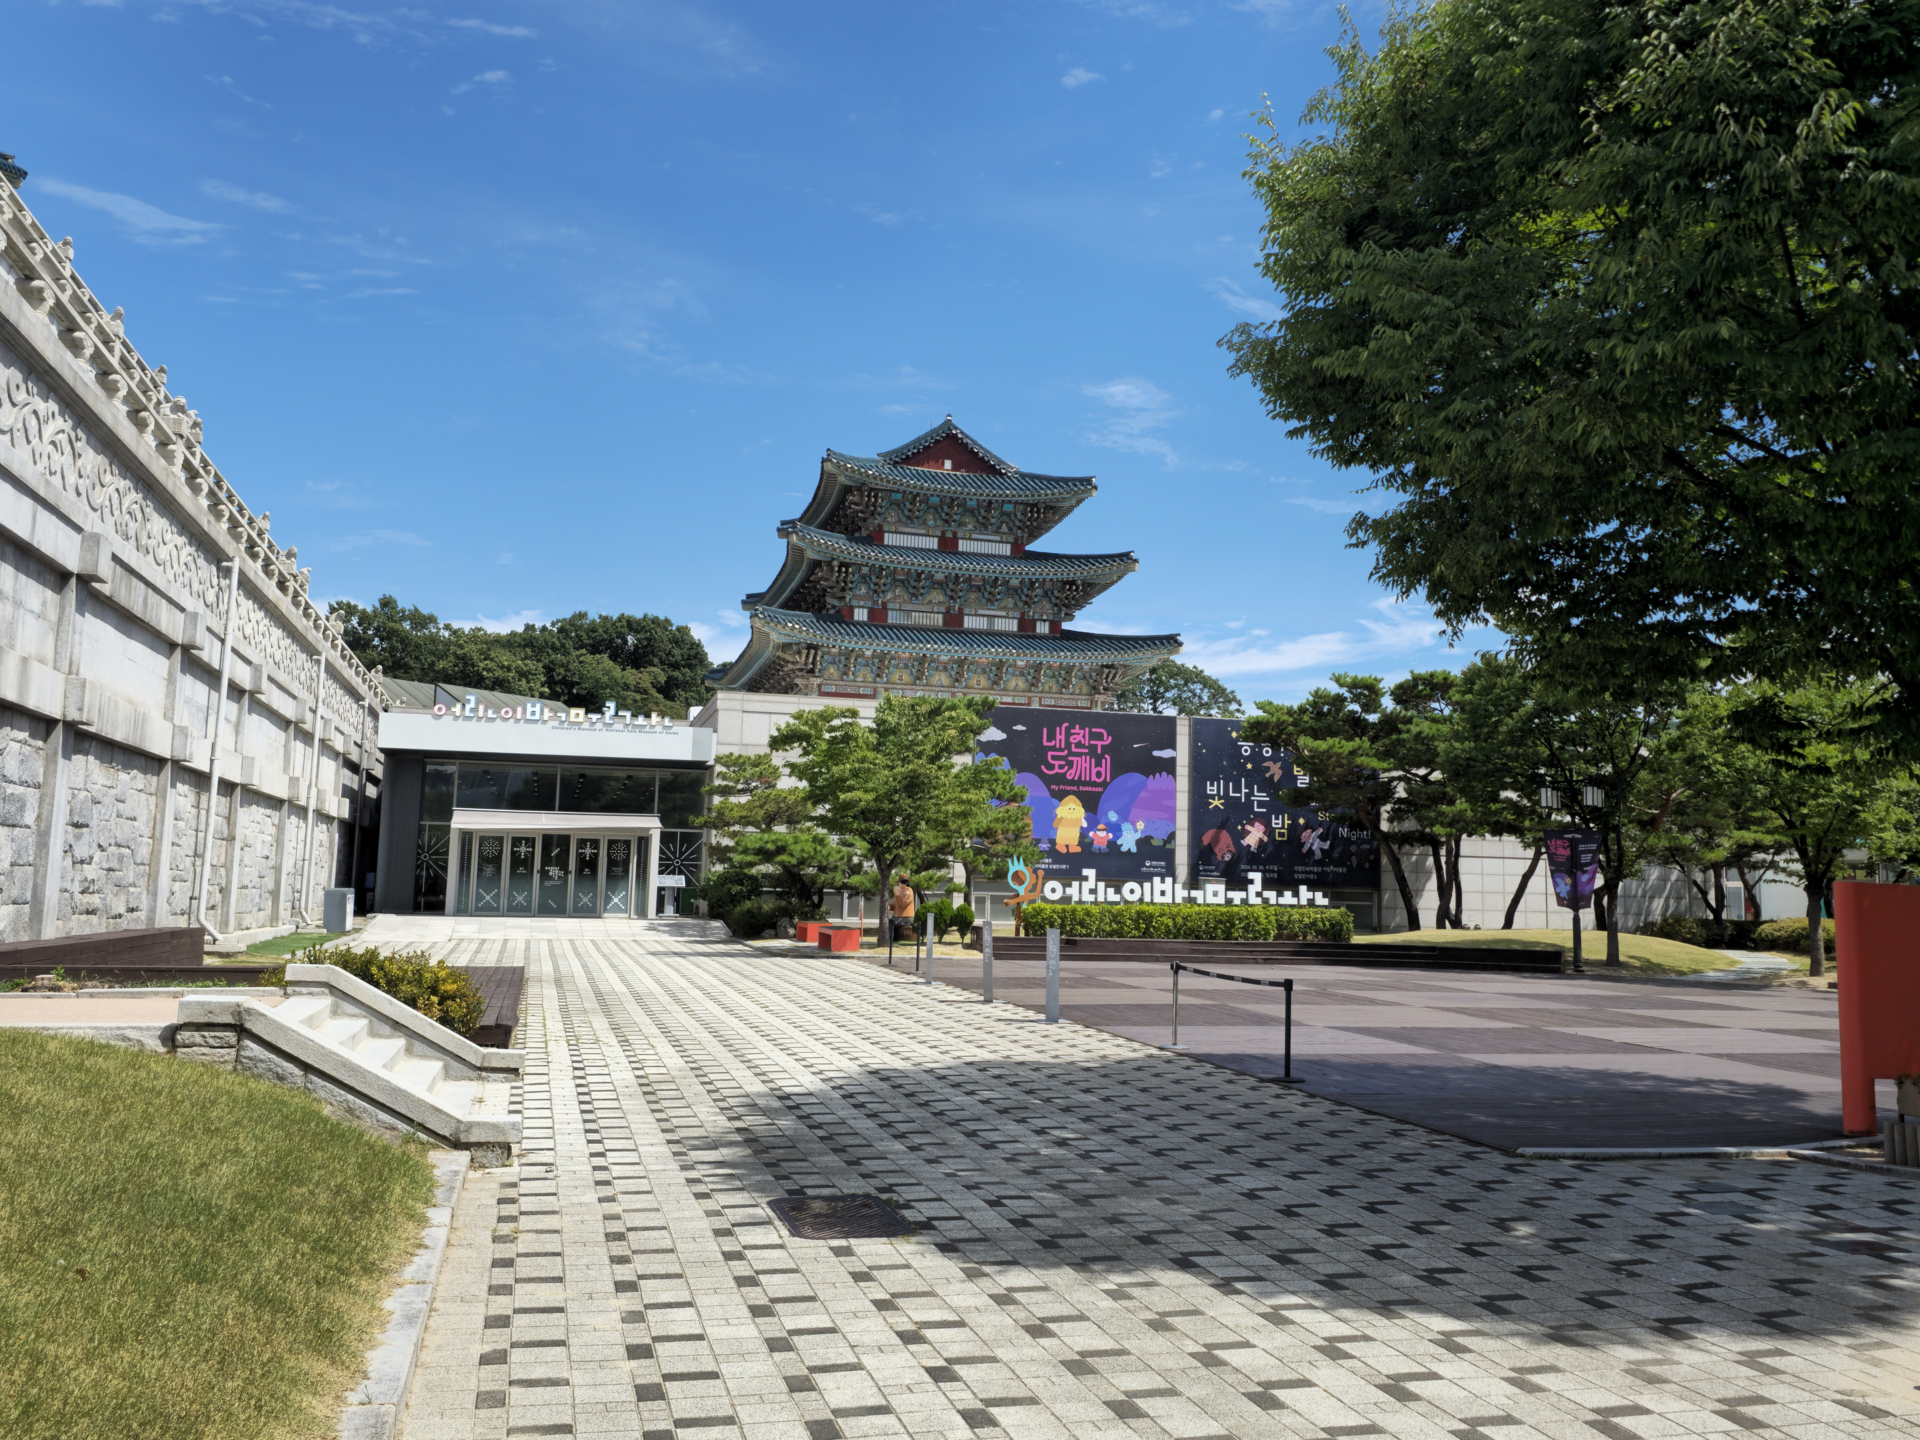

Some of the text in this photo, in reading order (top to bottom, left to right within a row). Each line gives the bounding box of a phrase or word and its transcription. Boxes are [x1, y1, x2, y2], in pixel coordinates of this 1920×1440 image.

[433, 694, 674, 727] 어린이박물관
[1043, 722, 1112, 754] 내 친구
[1040, 749, 1111, 782] 도깨비
[1272, 813, 1292, 840] 밤
[1338, 827, 1371, 841] Night!
[1043, 868, 1329, 906] 어린이박물관
